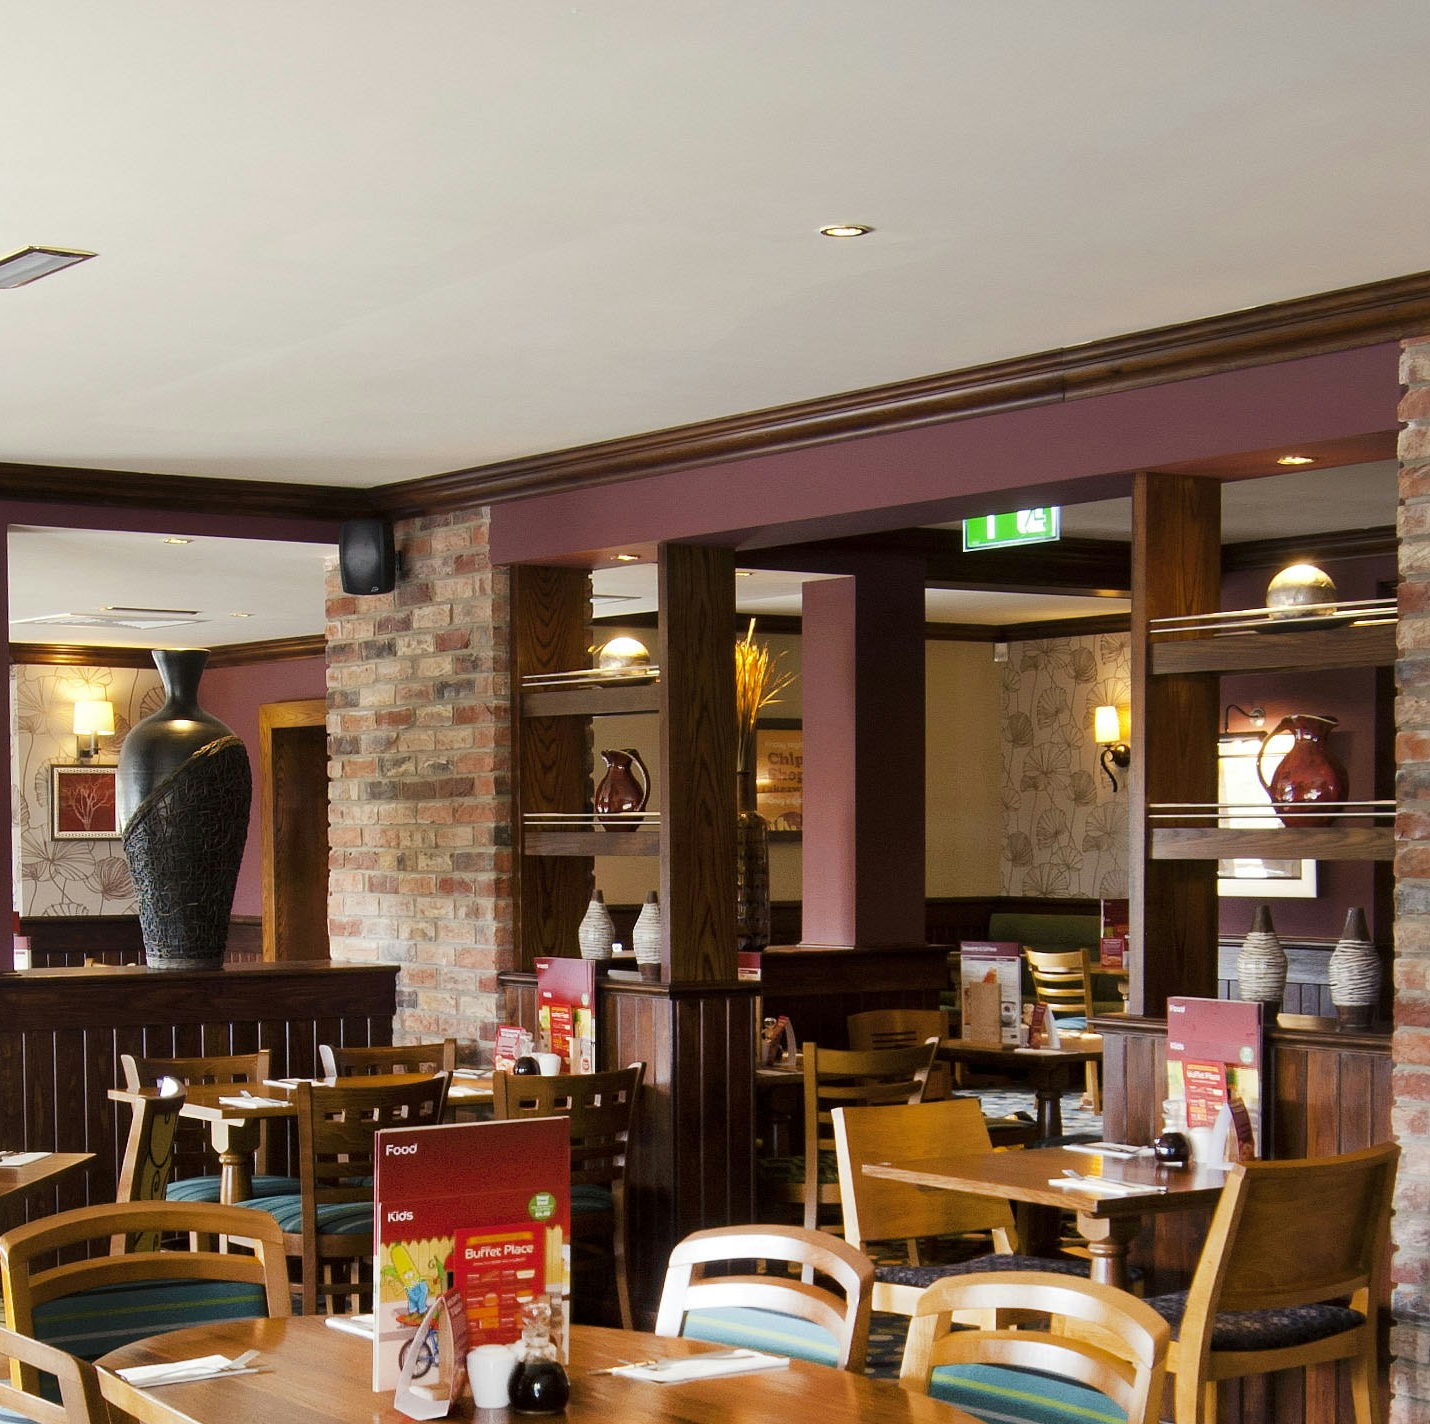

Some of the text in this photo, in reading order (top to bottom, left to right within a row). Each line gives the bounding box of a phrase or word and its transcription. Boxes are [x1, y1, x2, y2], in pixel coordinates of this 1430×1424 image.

[385, 1142, 418, 1156] Food
[387, 1210, 414, 1223] Kids
[465, 1244, 534, 1260] Buffet Place
